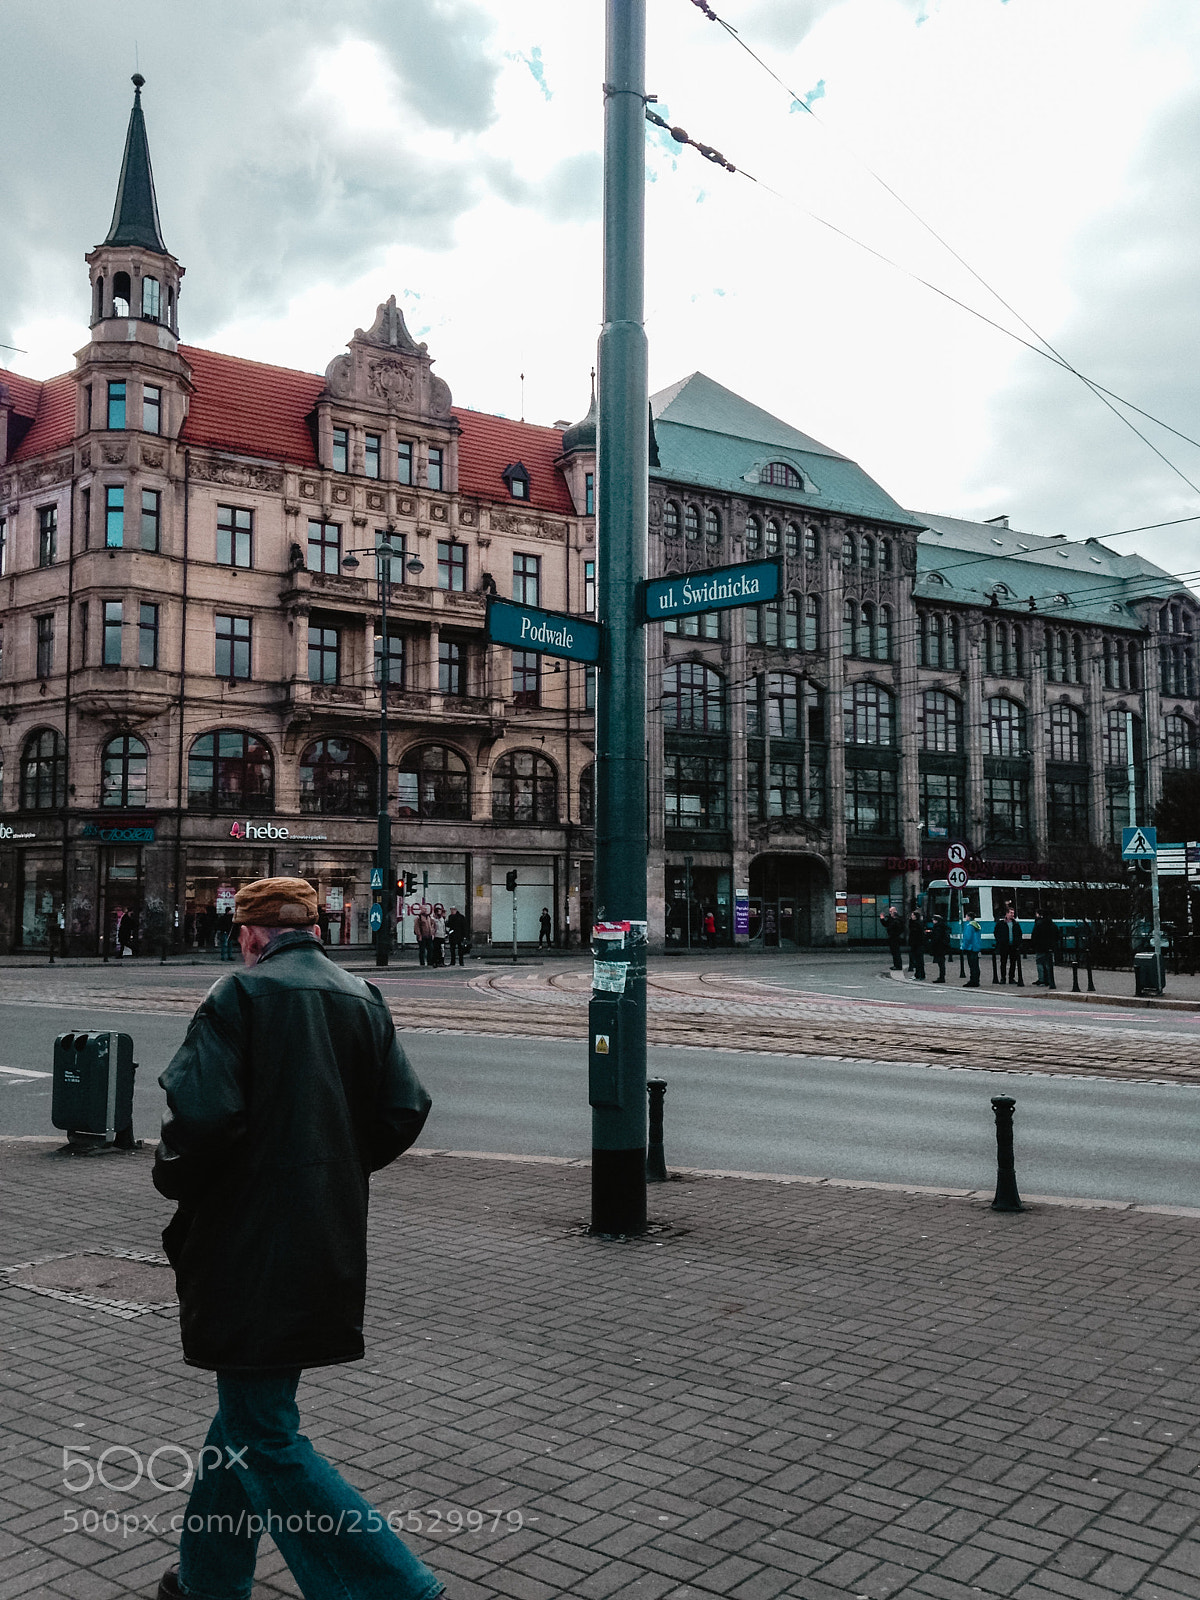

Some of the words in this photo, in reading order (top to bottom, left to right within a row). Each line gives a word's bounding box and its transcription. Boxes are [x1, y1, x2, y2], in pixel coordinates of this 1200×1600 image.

[659, 591, 677, 609] ul.
[683, 575, 759, 605] Świdnicka
[520, 617, 573, 648] Podwale
[246, 822, 289, 839] hebe
[950, 872, 966, 883] 40
